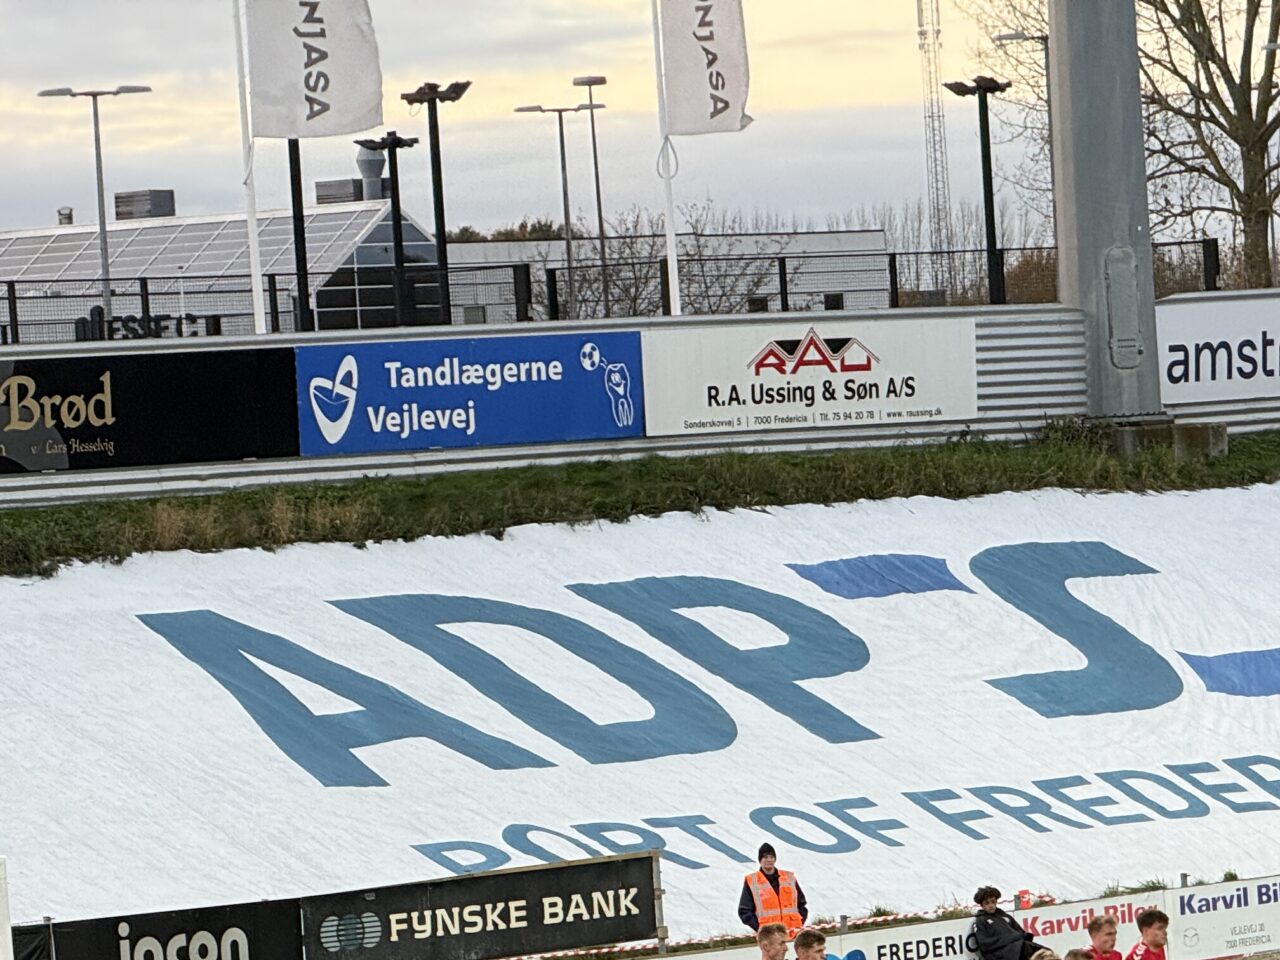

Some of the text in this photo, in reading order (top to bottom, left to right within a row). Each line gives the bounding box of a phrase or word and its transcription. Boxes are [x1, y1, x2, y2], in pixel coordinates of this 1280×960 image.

[692, 0, 730, 119] NJASA
[385, 357, 563, 391] Tandlægerne
[707, 376, 916, 407] R.A. Ussing & Søn A/S
[0, 370, 116, 432] Brød
[753, 415, 772, 425] 7000
[774, 414, 808, 424] Fredericia
[832, 412, 841, 420] 75
[843, 411, 852, 420] 94
[855, 410, 864, 420] 20
[367, 400, 476, 439] Vejlevej
[749, 796, 905, 854] OF
[388, 887, 640, 943] FYNSKE BANK
[1179, 886, 1250, 916] Karvil
[1022, 907, 1096, 938] Karvil
